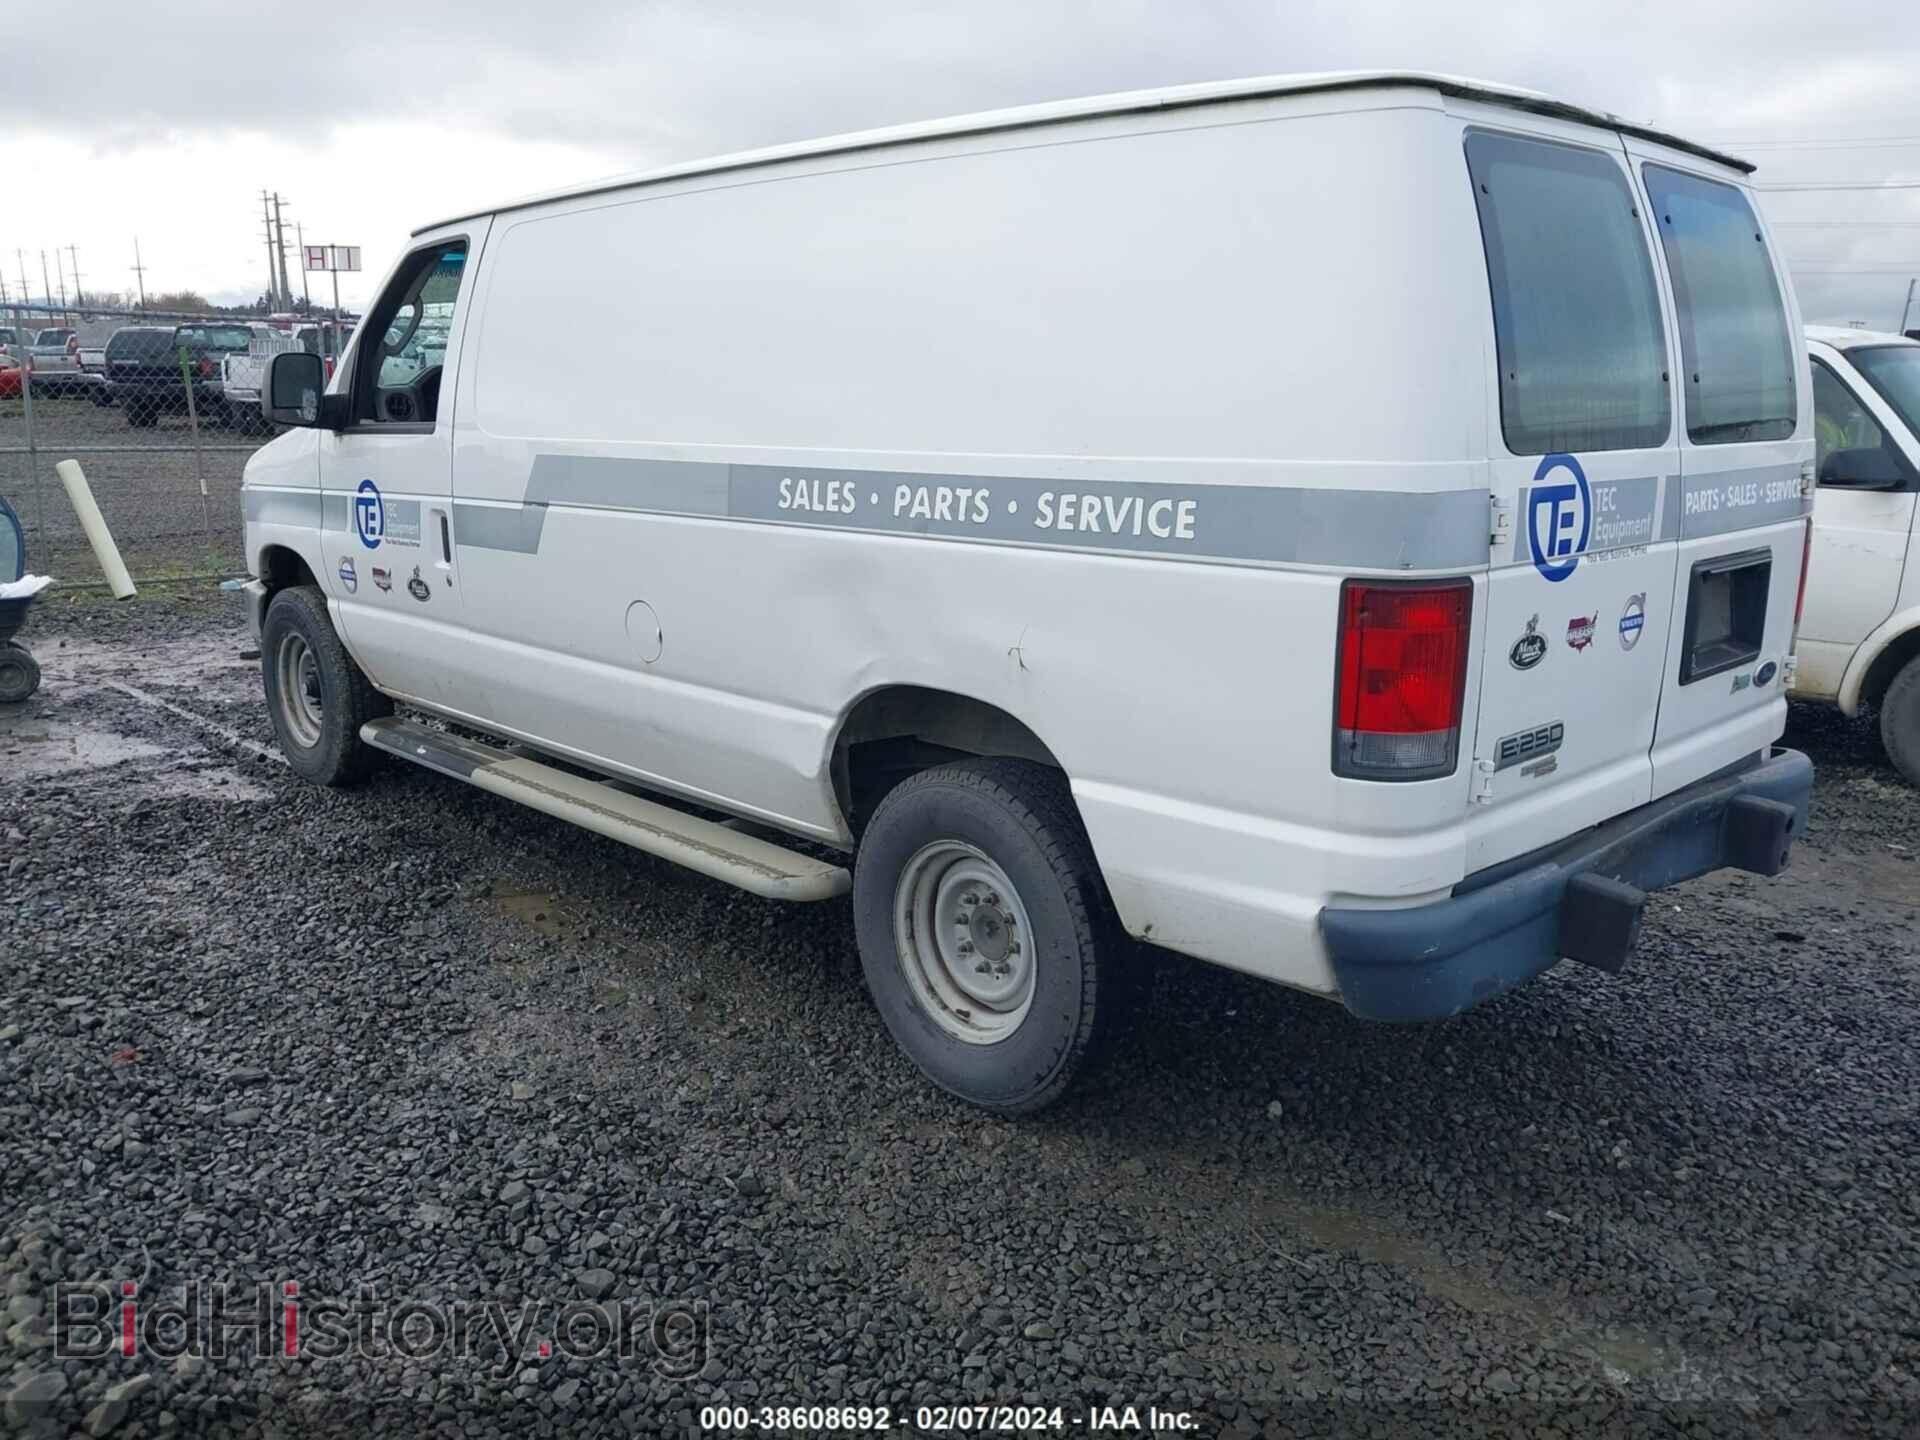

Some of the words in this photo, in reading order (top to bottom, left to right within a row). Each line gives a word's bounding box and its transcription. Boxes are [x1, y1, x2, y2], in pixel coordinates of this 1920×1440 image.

[778, 478, 856, 514] SALES
[893, 484, 990, 523] PARTS
[1034, 491, 1197, 540] SERVICE
[1595, 486, 1617, 512] TEC
[1685, 487, 1720, 515] PARTS
[1727, 482, 1758, 508] SALES
[1595, 512, 1652, 544] Equipment
